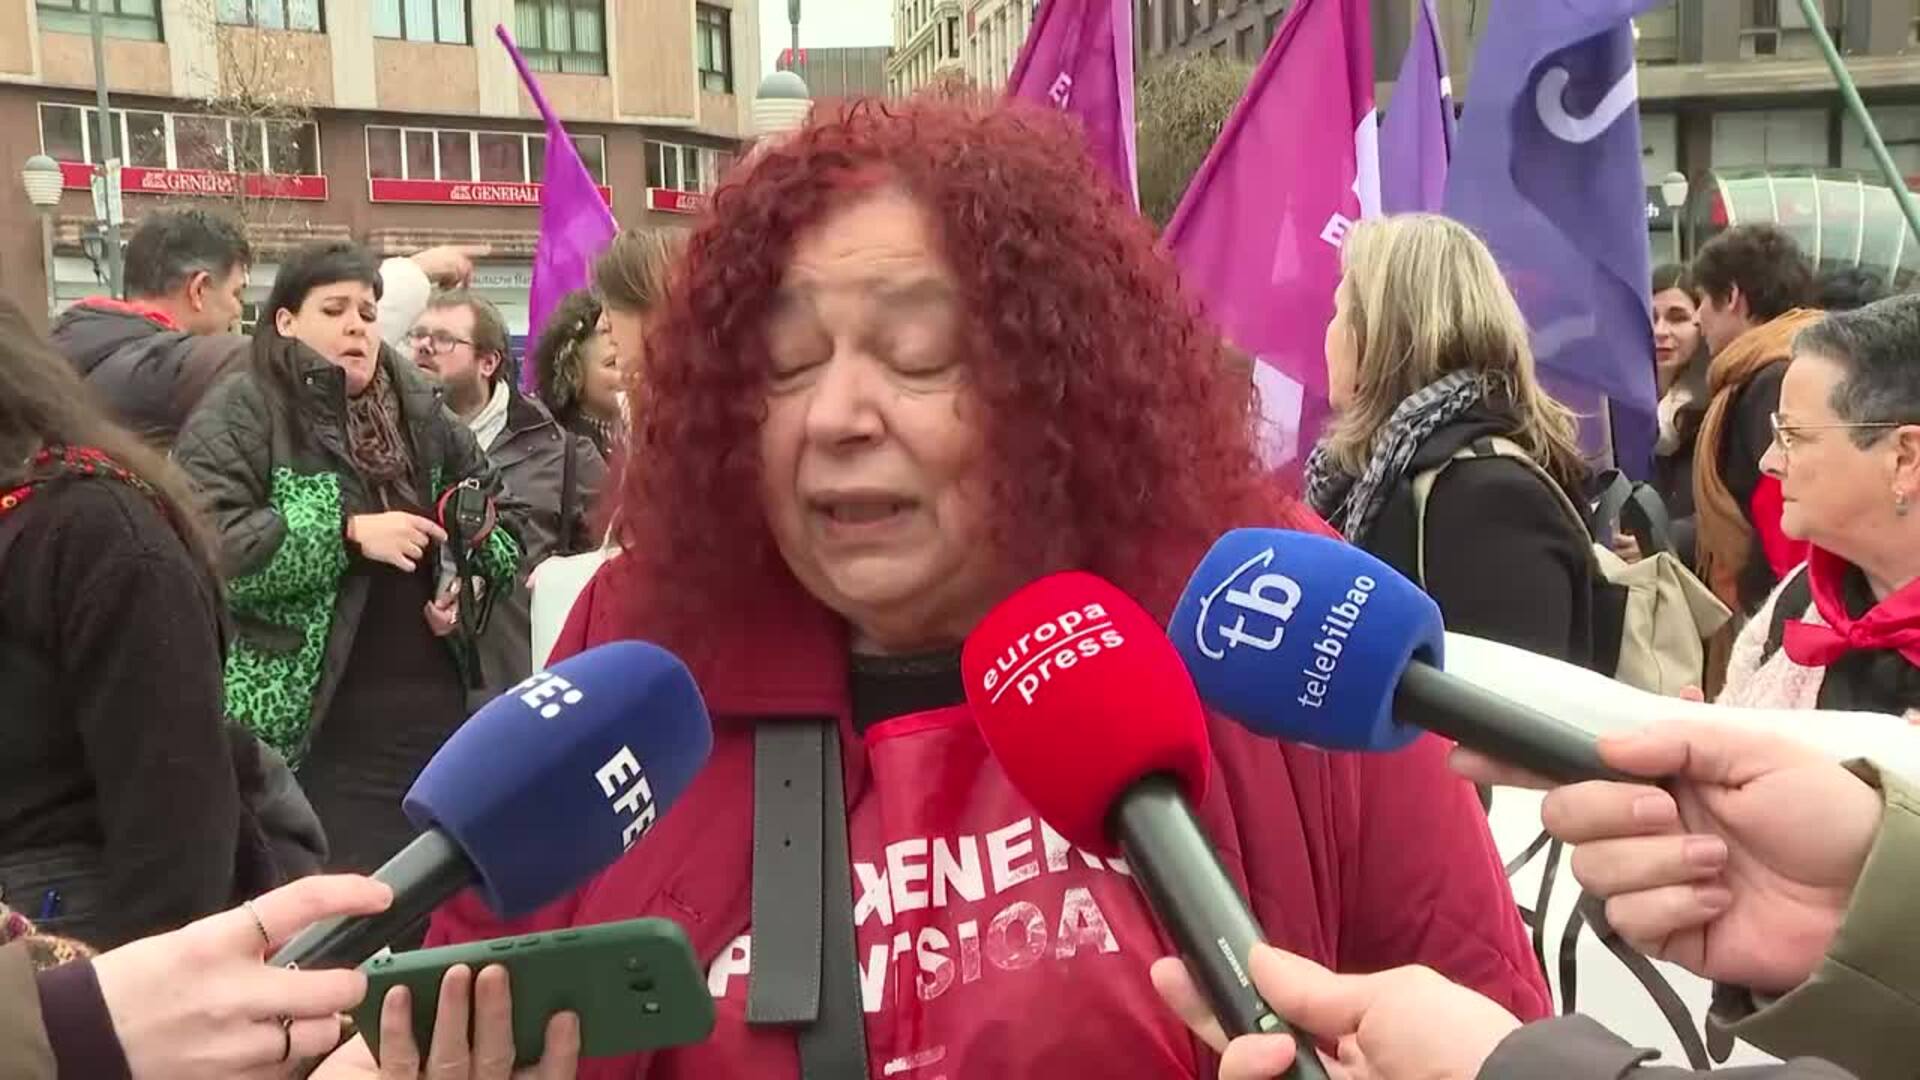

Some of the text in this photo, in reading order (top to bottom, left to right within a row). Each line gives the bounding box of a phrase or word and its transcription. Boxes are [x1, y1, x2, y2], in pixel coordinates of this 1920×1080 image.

[471, 185, 539, 202] GENERALI
[983, 603, 1107, 691] europa
[1016, 629, 1125, 705] press
[1297, 575, 1376, 708] telebilbao
